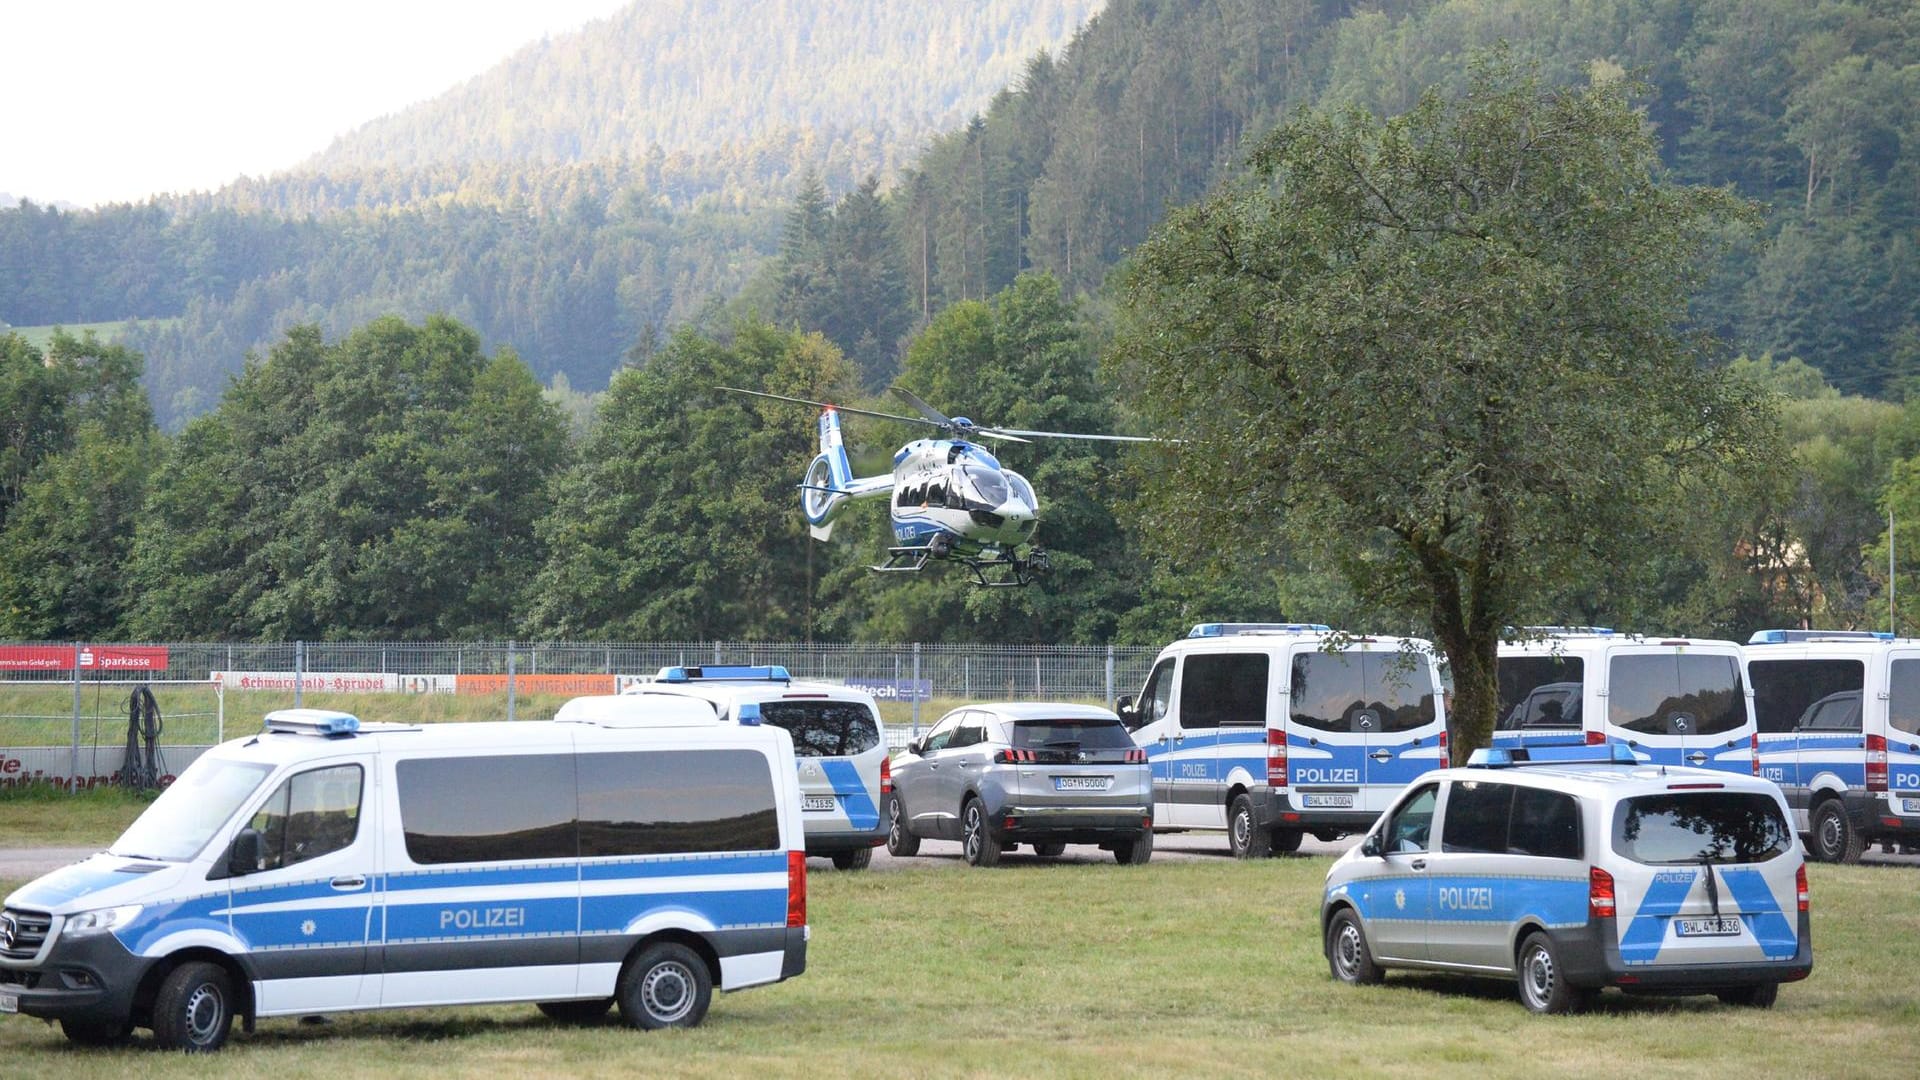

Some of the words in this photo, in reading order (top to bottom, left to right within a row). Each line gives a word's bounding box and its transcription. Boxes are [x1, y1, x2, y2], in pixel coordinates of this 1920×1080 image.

[28, 658, 45, 666] Geld
[99, 656, 150, 668] Sparkasse
[1182, 764, 1207, 777] POLIZEI
[1296, 768, 1358, 783] POLIZEI
[1656, 873, 1694, 883] POLIZEI
[1439, 887, 1492, 910] POLIZEI
[440, 907, 525, 929] POLIZEI
[1684, 920, 1702, 932] BWL
